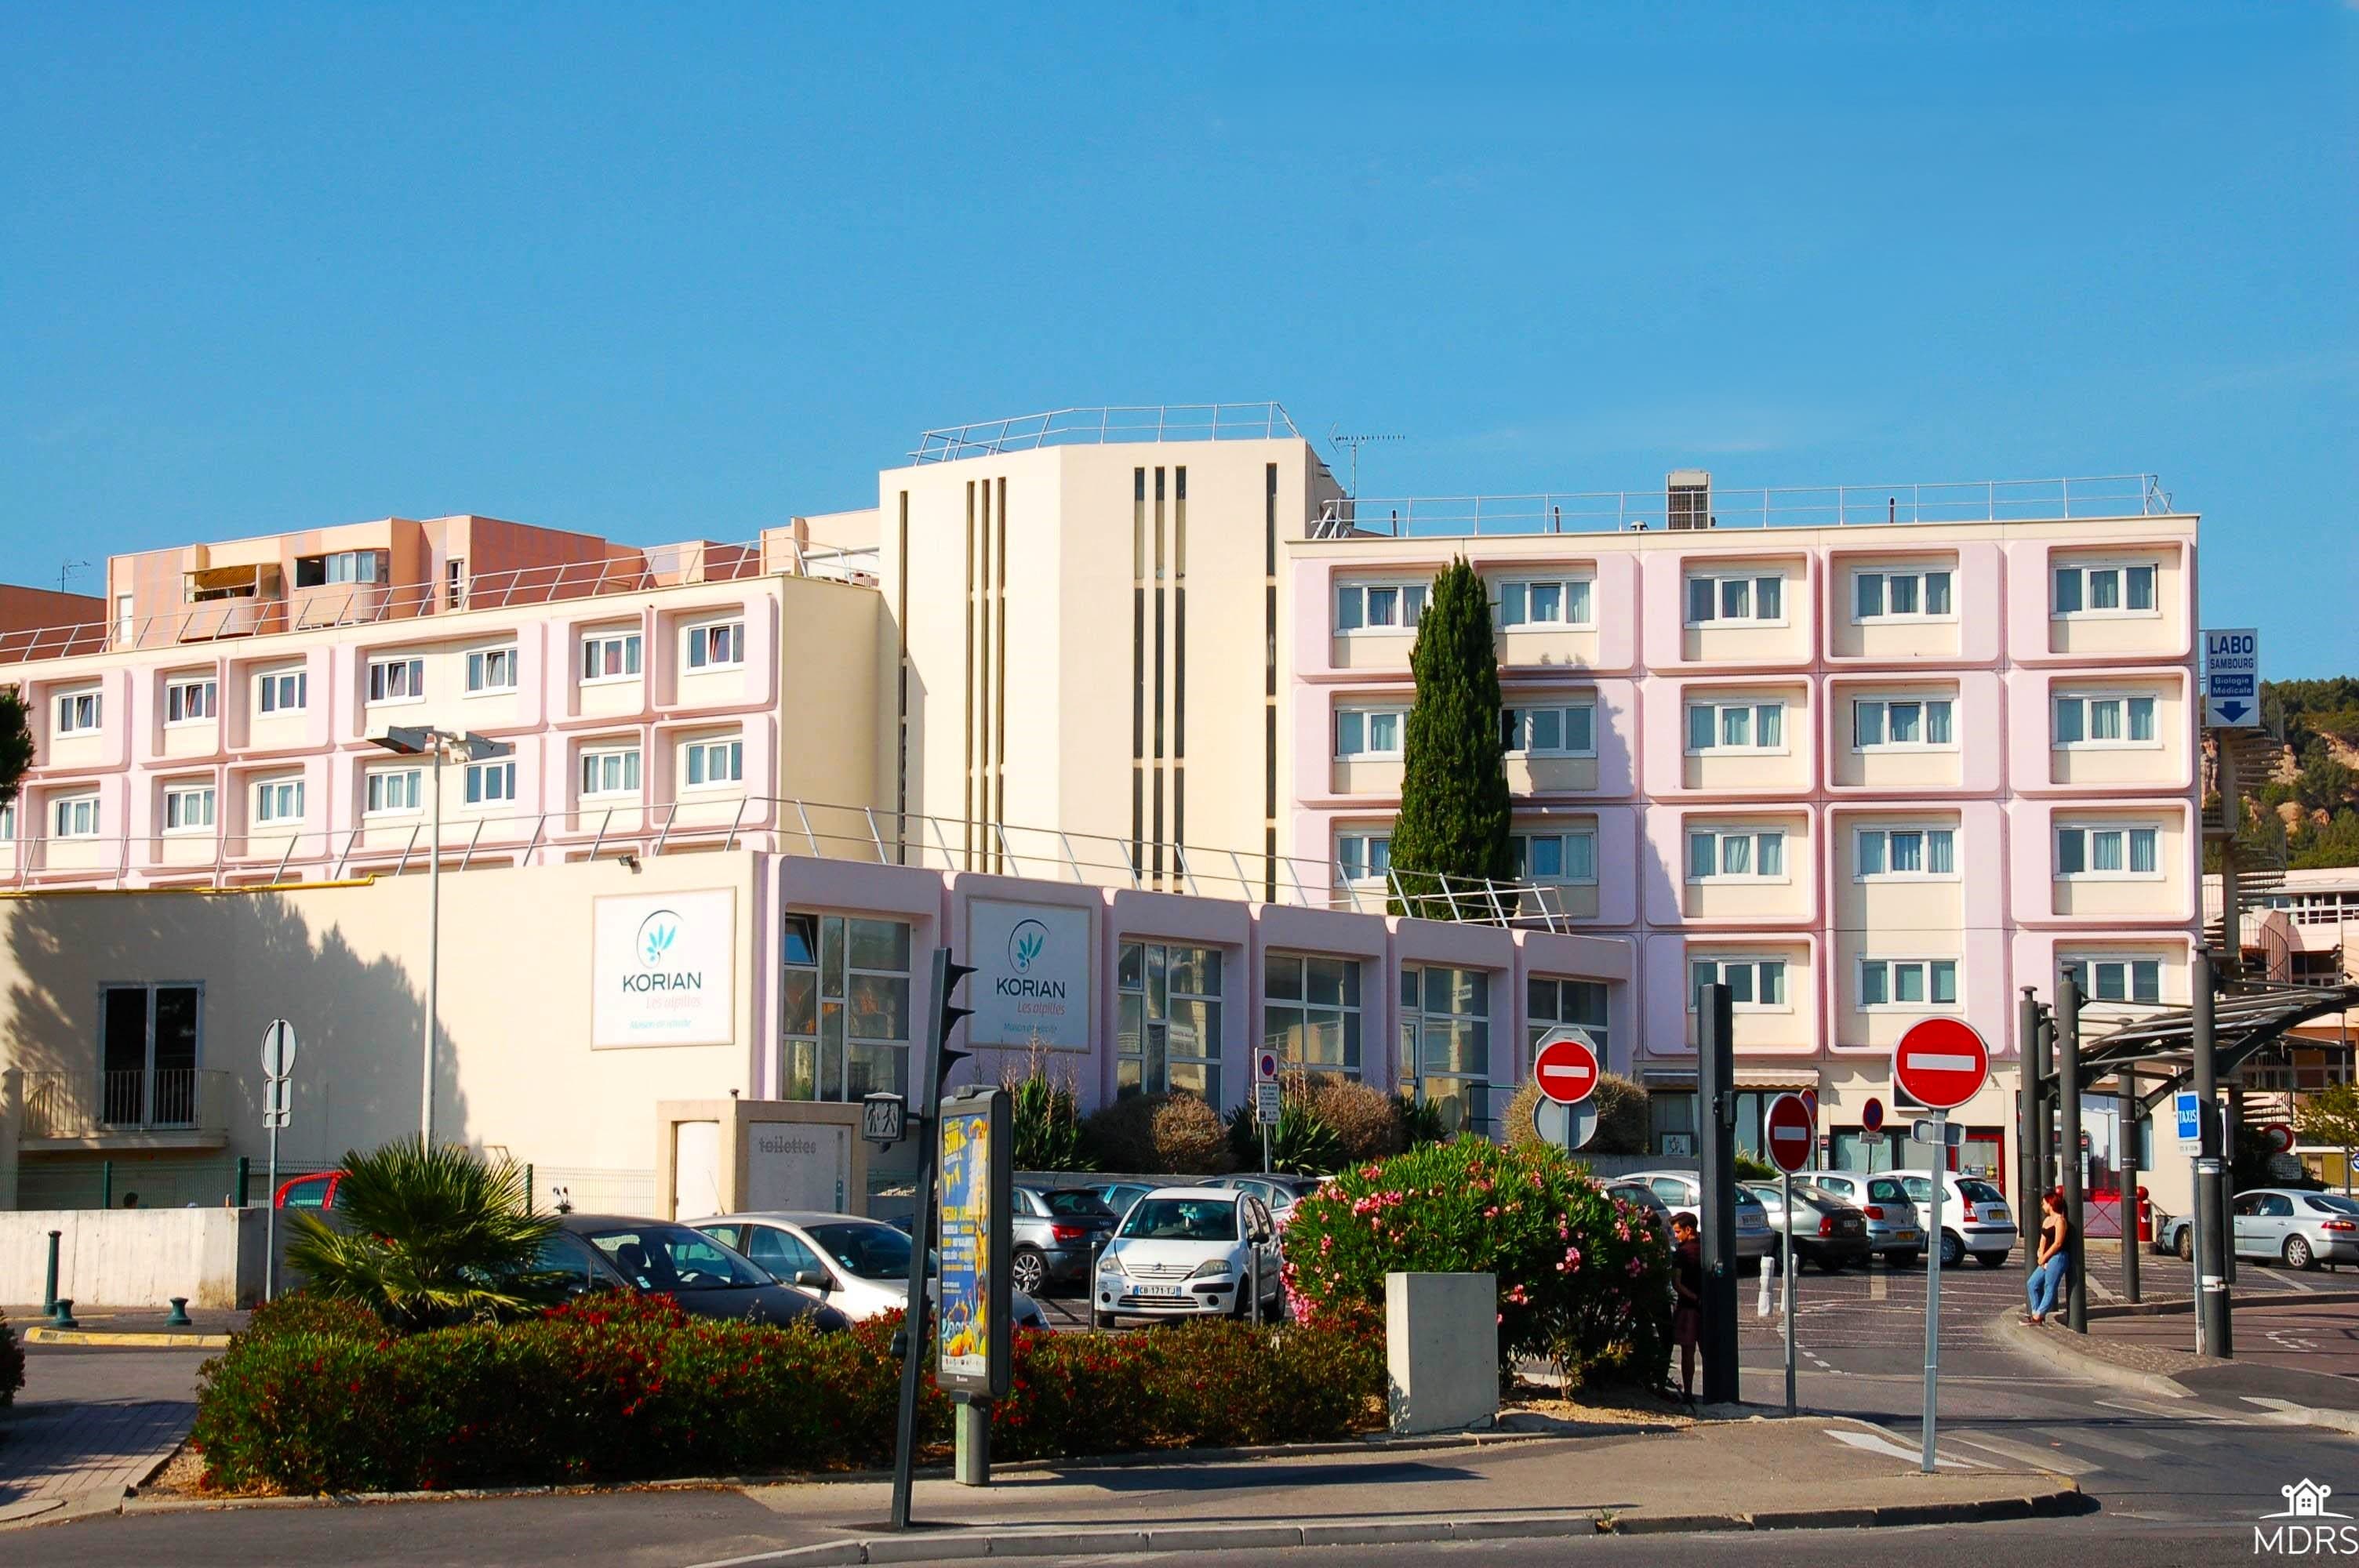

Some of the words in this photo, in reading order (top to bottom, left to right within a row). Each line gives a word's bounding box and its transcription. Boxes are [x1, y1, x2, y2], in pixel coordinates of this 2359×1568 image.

[2209, 635, 2254, 655] LABO
[2210, 658, 2254, 670] SAMBOURG
[2215, 677, 2249, 686] Biologie
[623, 971, 702, 993] KORIAN
[996, 978, 1066, 999] KORIAN
[1017, 1001, 1030, 1014] Les
[2179, 1109, 2197, 1124] TAXIS
[758, 1135, 816, 1154] toilettes
